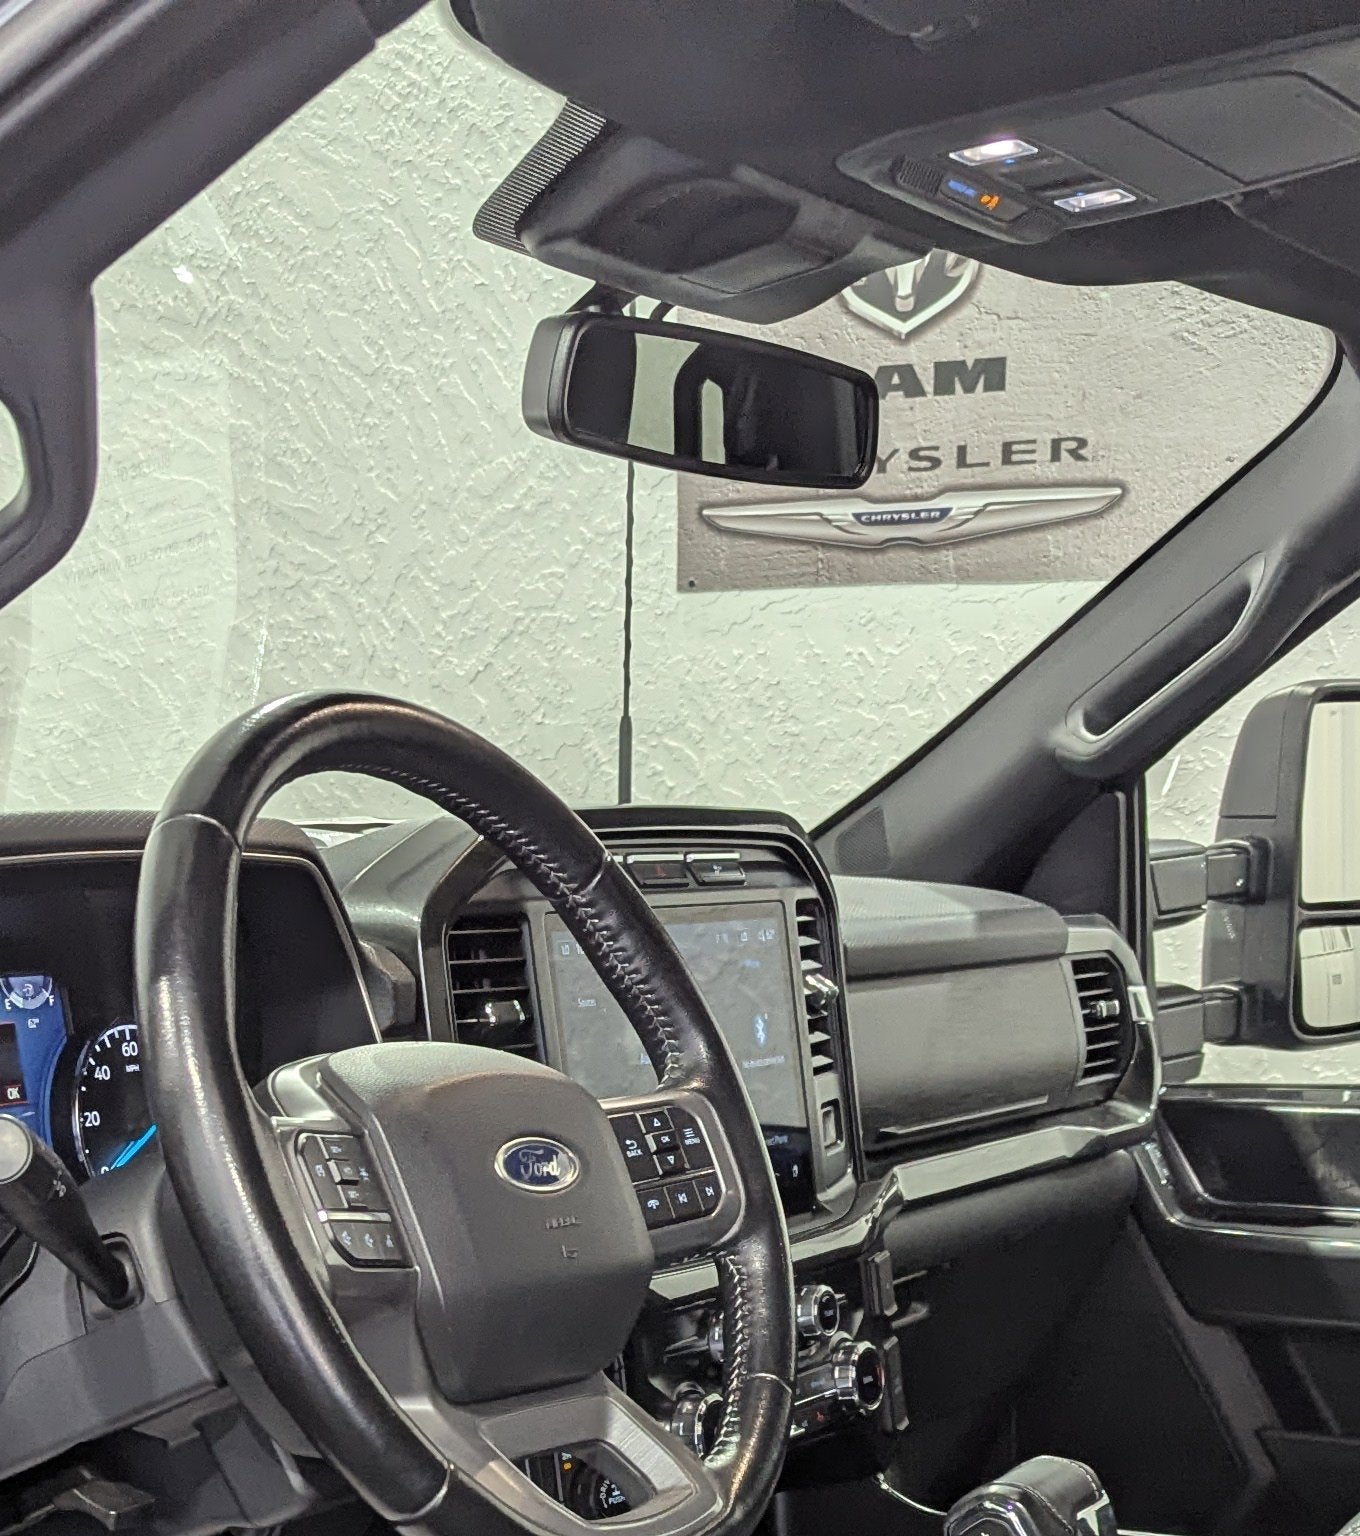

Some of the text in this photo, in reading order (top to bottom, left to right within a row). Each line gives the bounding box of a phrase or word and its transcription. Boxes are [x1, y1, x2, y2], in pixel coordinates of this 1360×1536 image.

[861, 511, 940, 522] CHRYSLER
[121, 1041, 138, 1057] 60
[94, 1065, 111, 1080] 40
[7, 1088, 20, 1100] OK
[83, 1111, 101, 1127] 20
[519, 1148, 561, 1181] Ford
